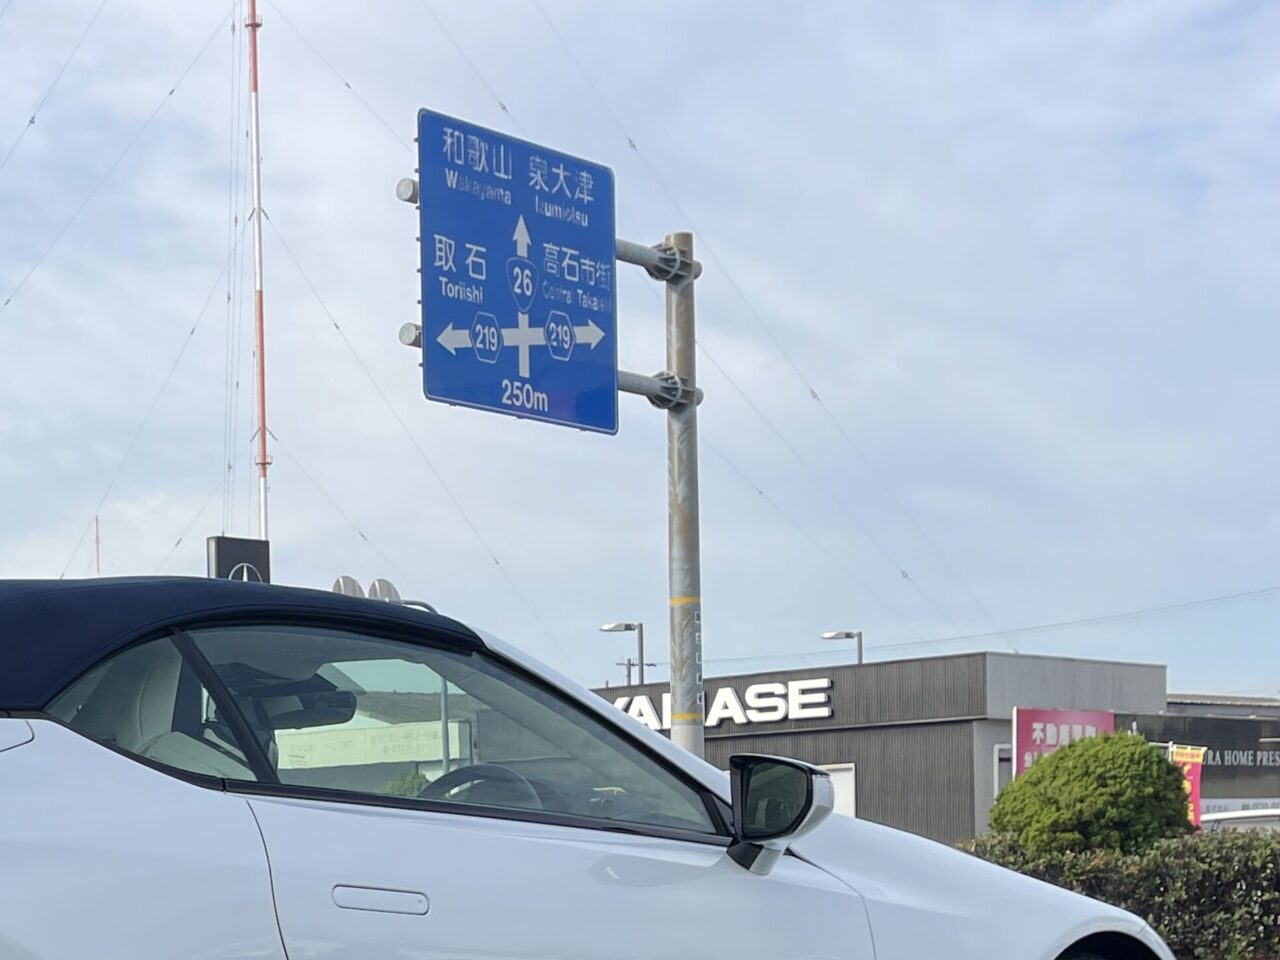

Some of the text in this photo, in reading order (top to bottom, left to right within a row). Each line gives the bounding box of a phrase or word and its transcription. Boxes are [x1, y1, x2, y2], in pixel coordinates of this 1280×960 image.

[442, 127, 512, 180] 和歌山
[528, 155, 594, 205] 泉大津
[438, 276, 484, 305] Toriishi
[513, 266, 533, 297] 26
[475, 323, 499, 352] 219
[549, 321, 571, 350] 219
[501, 379, 549, 412] 250m
[613, 678, 832, 731] AASE
[1224, 749, 1255, 766] HOME
